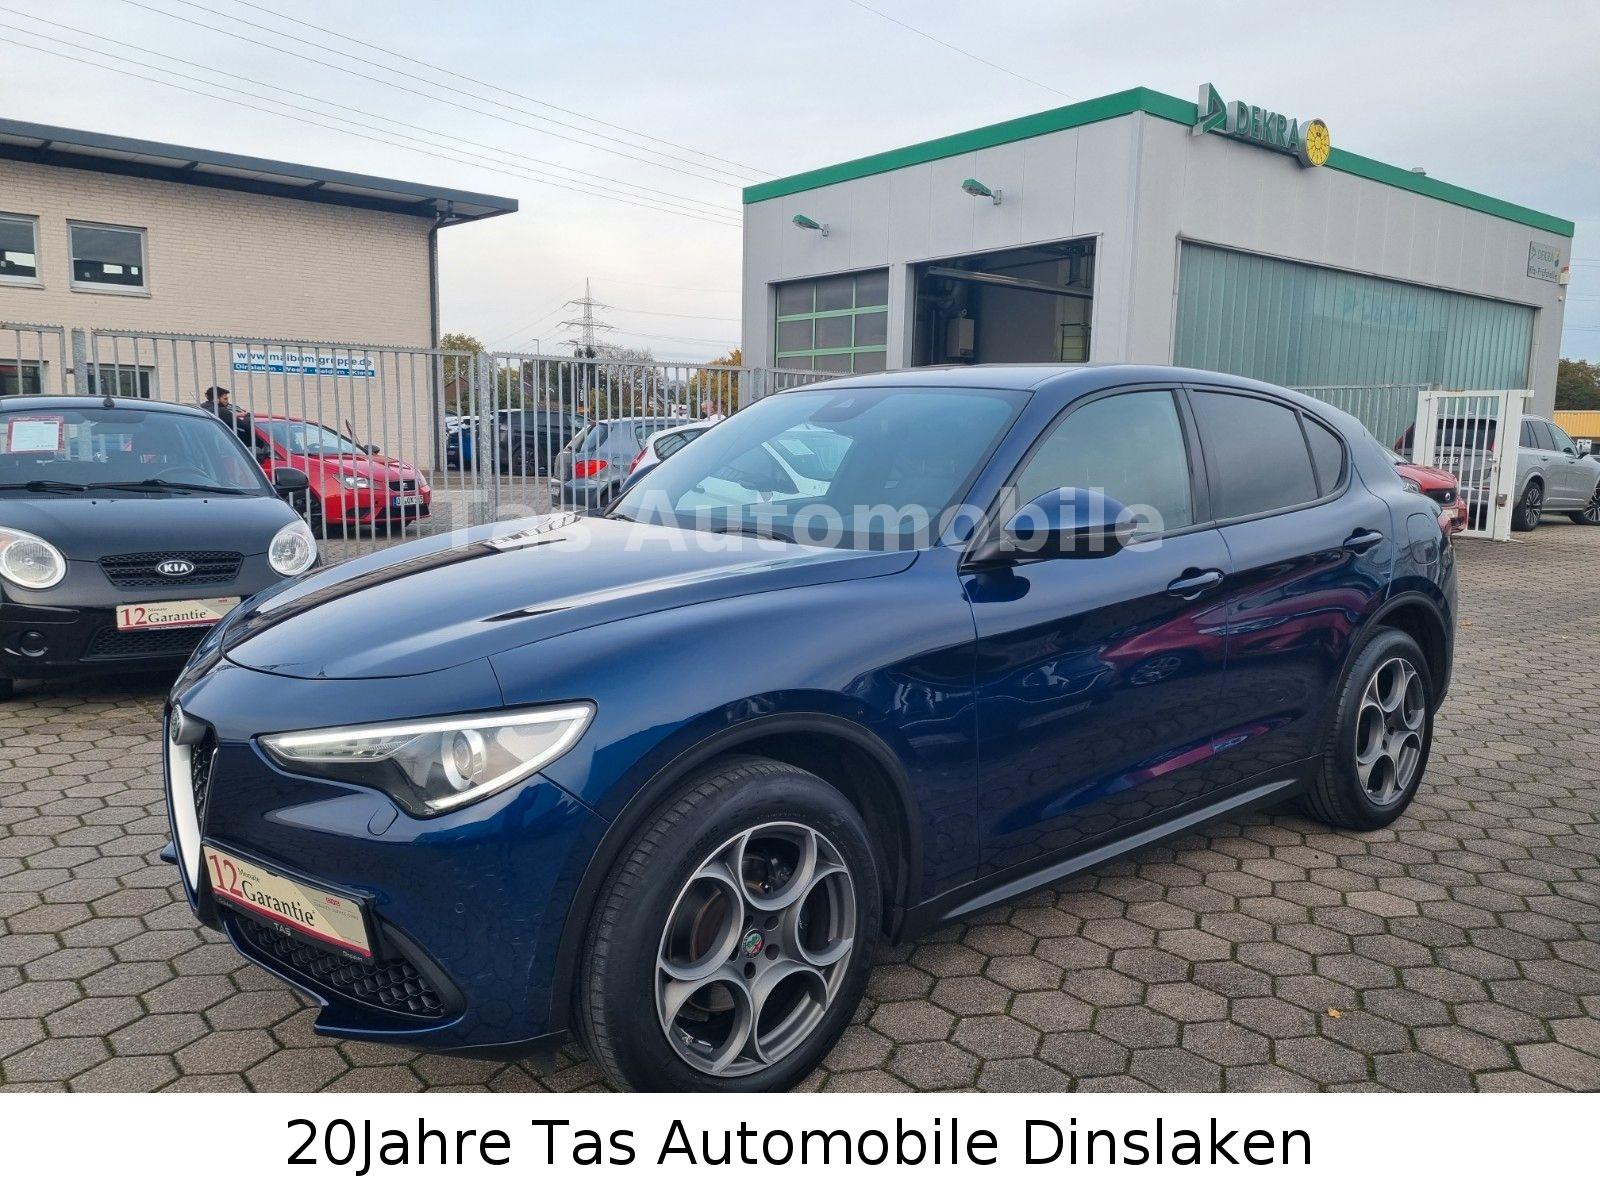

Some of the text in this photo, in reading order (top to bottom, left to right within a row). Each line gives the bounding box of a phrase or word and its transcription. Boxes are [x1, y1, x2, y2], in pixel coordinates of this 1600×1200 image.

[1233, 100, 1300, 150] DEKRA
[236, 352, 372, 366] wwwmaibom-grppe.de
[164, 563, 189, 572] KIA
[121, 607, 147, 626] 12
[148, 609, 206, 623] Garantie
[208, 854, 243, 898] 12
[241, 880, 315, 926] Garantie
[274, 922, 292, 936] TAS
